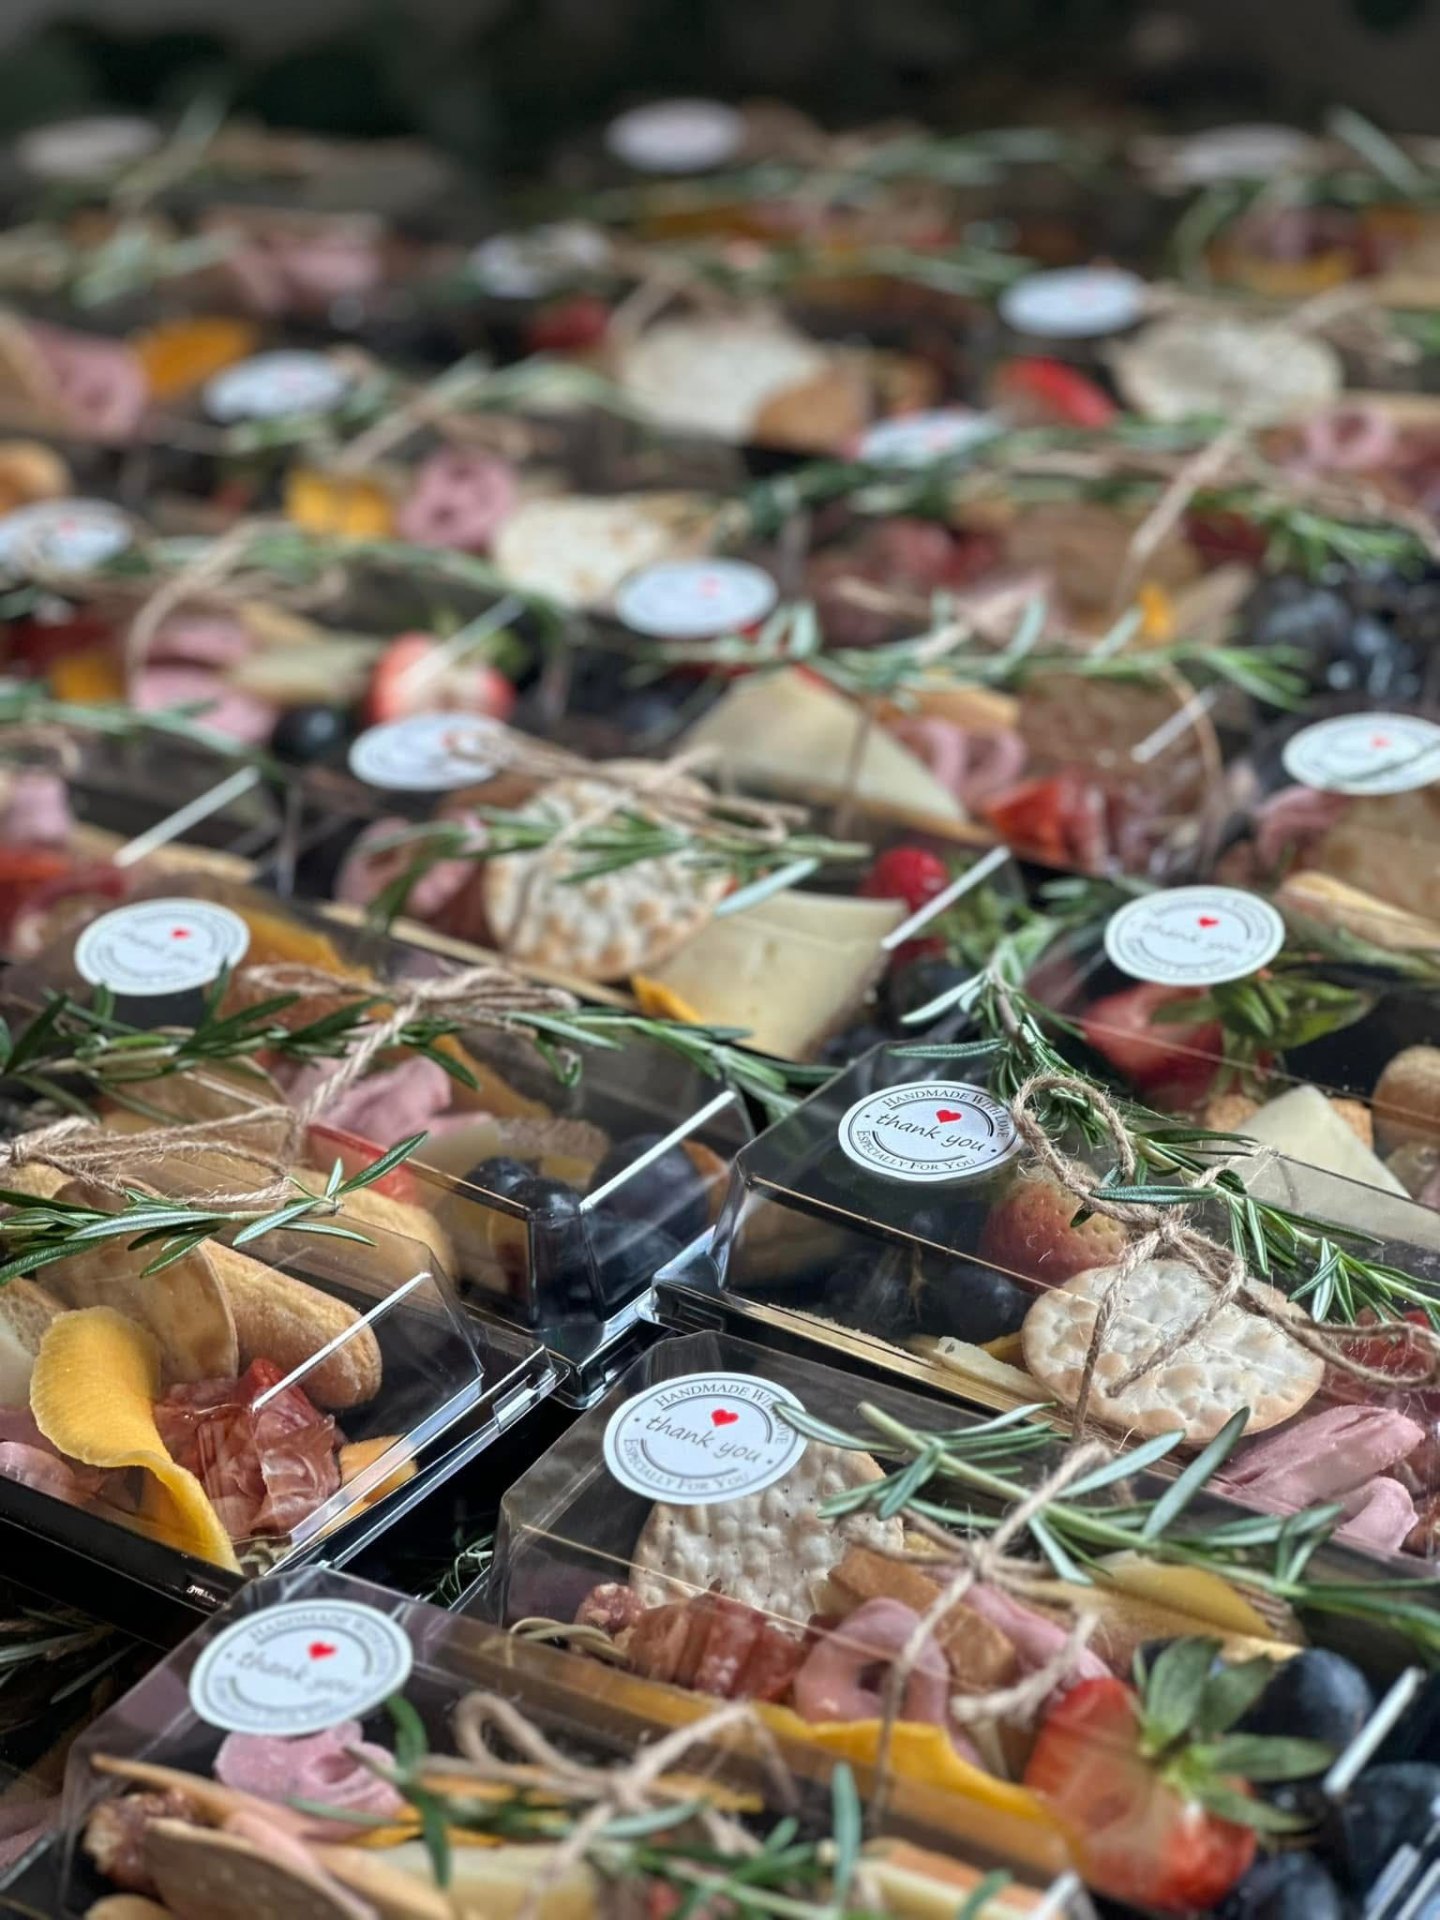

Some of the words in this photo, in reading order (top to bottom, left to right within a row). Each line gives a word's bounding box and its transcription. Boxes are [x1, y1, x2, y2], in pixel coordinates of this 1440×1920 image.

[881, 1088, 970, 1108] HANDMADE
[855, 1129, 910, 1169] ESPECIALLY
[908, 1161, 940, 1171] FOR
[942, 1157, 976, 1170] YOU
[875, 1112, 941, 1140] thank
[940, 1133, 987, 1153] you
[654, 1383, 750, 1408] HANDMADE
[645, 1415, 717, 1449] thank
[713, 1440, 764, 1465] you
[622, 1438, 674, 1488] ESPECIALLY
[674, 1476, 710, 1491] FOR
[714, 1472, 750, 1489] YOU
